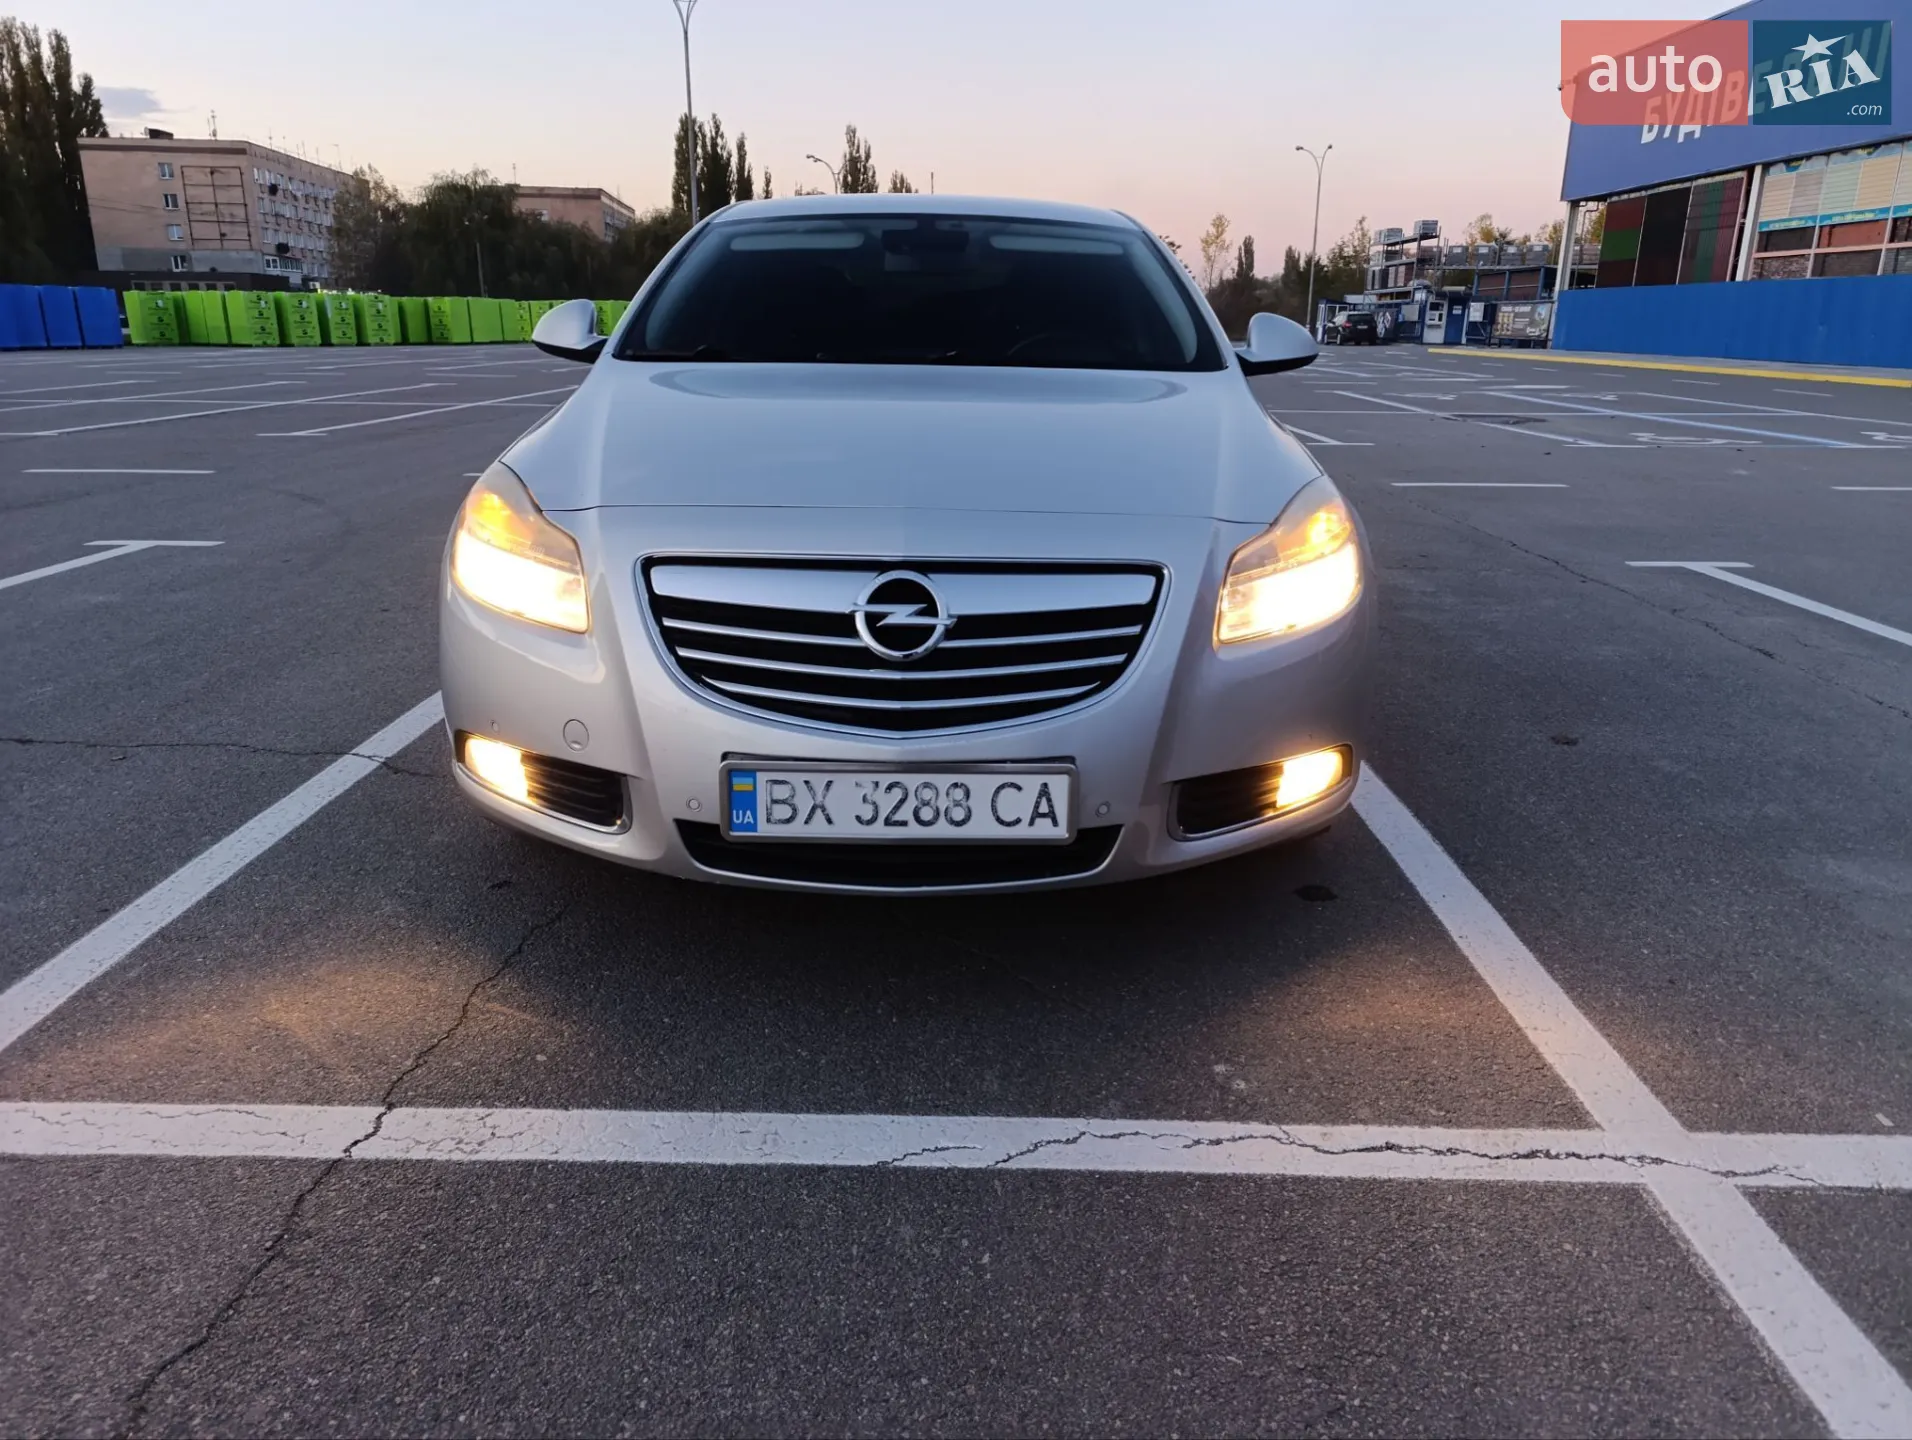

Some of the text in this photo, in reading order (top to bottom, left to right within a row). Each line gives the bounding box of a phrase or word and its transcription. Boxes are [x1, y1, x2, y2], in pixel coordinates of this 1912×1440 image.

[732, 810, 755, 825] UA
[765, 779, 1059, 828] BX 3288 CA
